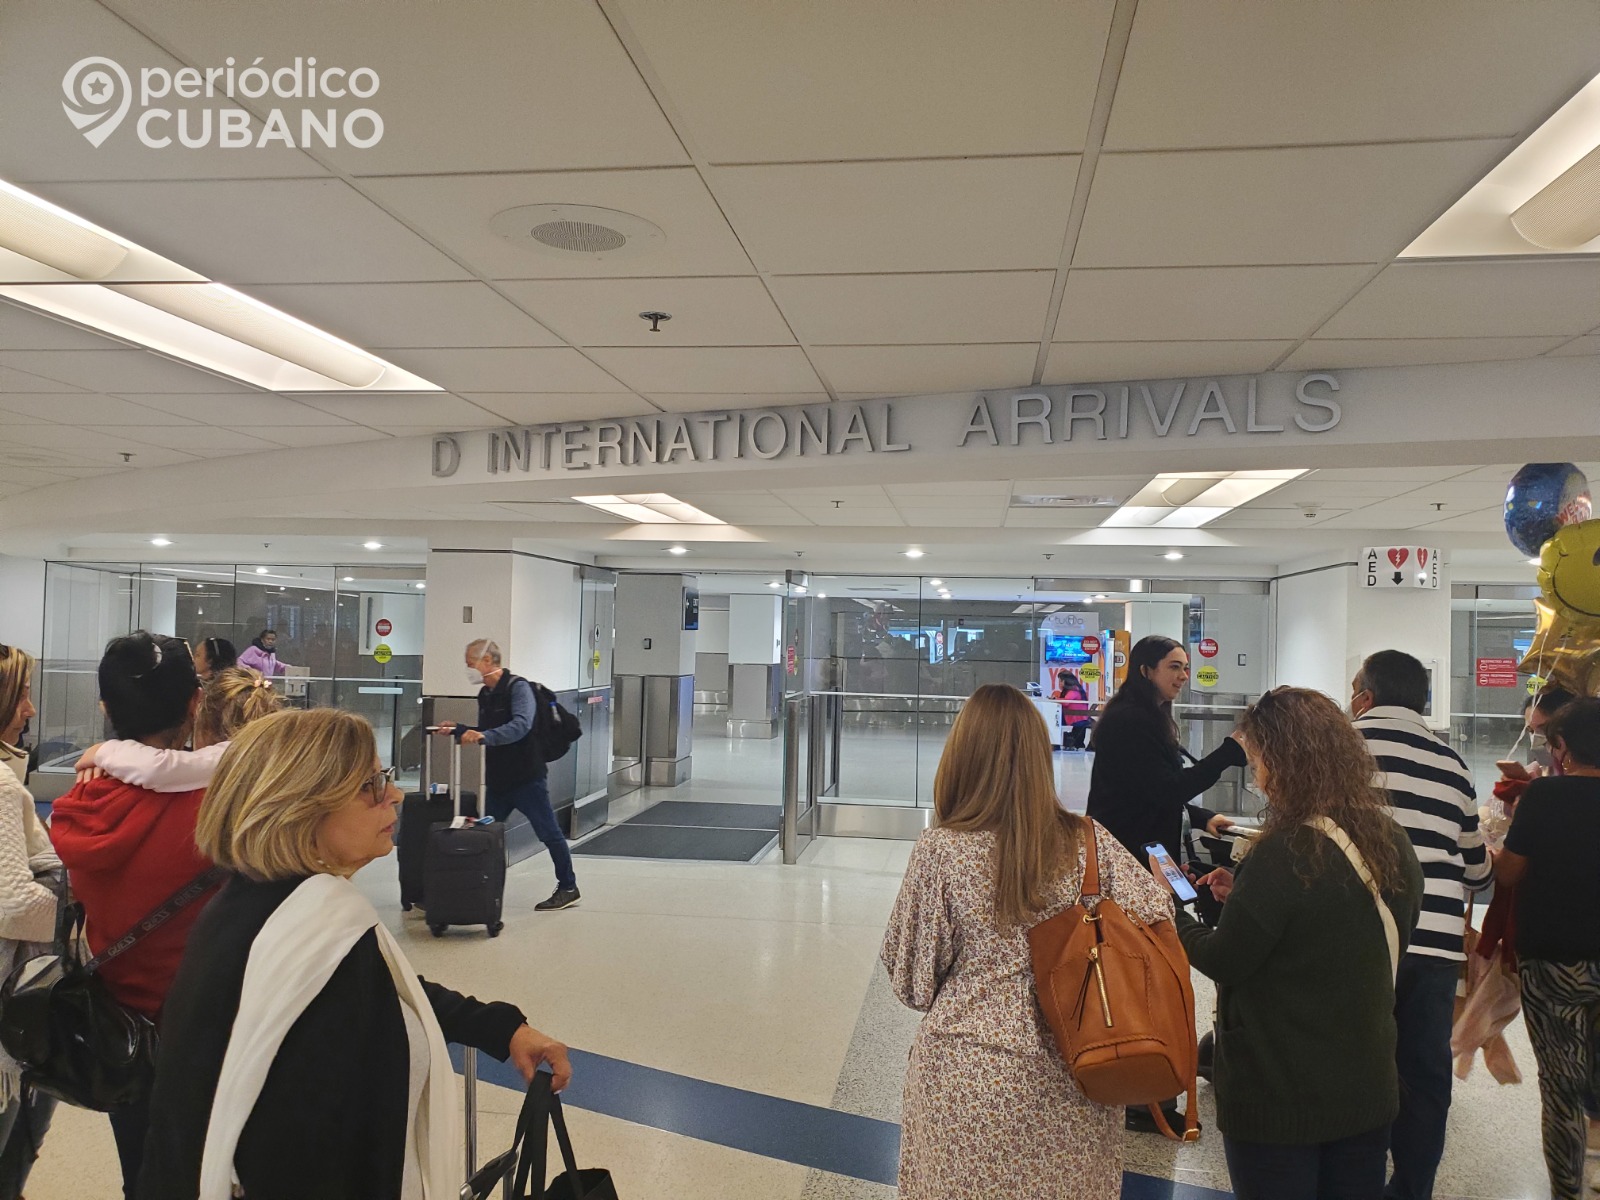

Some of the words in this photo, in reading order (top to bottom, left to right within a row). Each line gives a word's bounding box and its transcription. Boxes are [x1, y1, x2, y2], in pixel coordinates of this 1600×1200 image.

[431, 435, 461, 478] D
[487, 403, 911, 474] INTERNATIONAL
[957, 374, 1342, 447] ARRIVALS
[1367, 548, 1378, 587] AED
